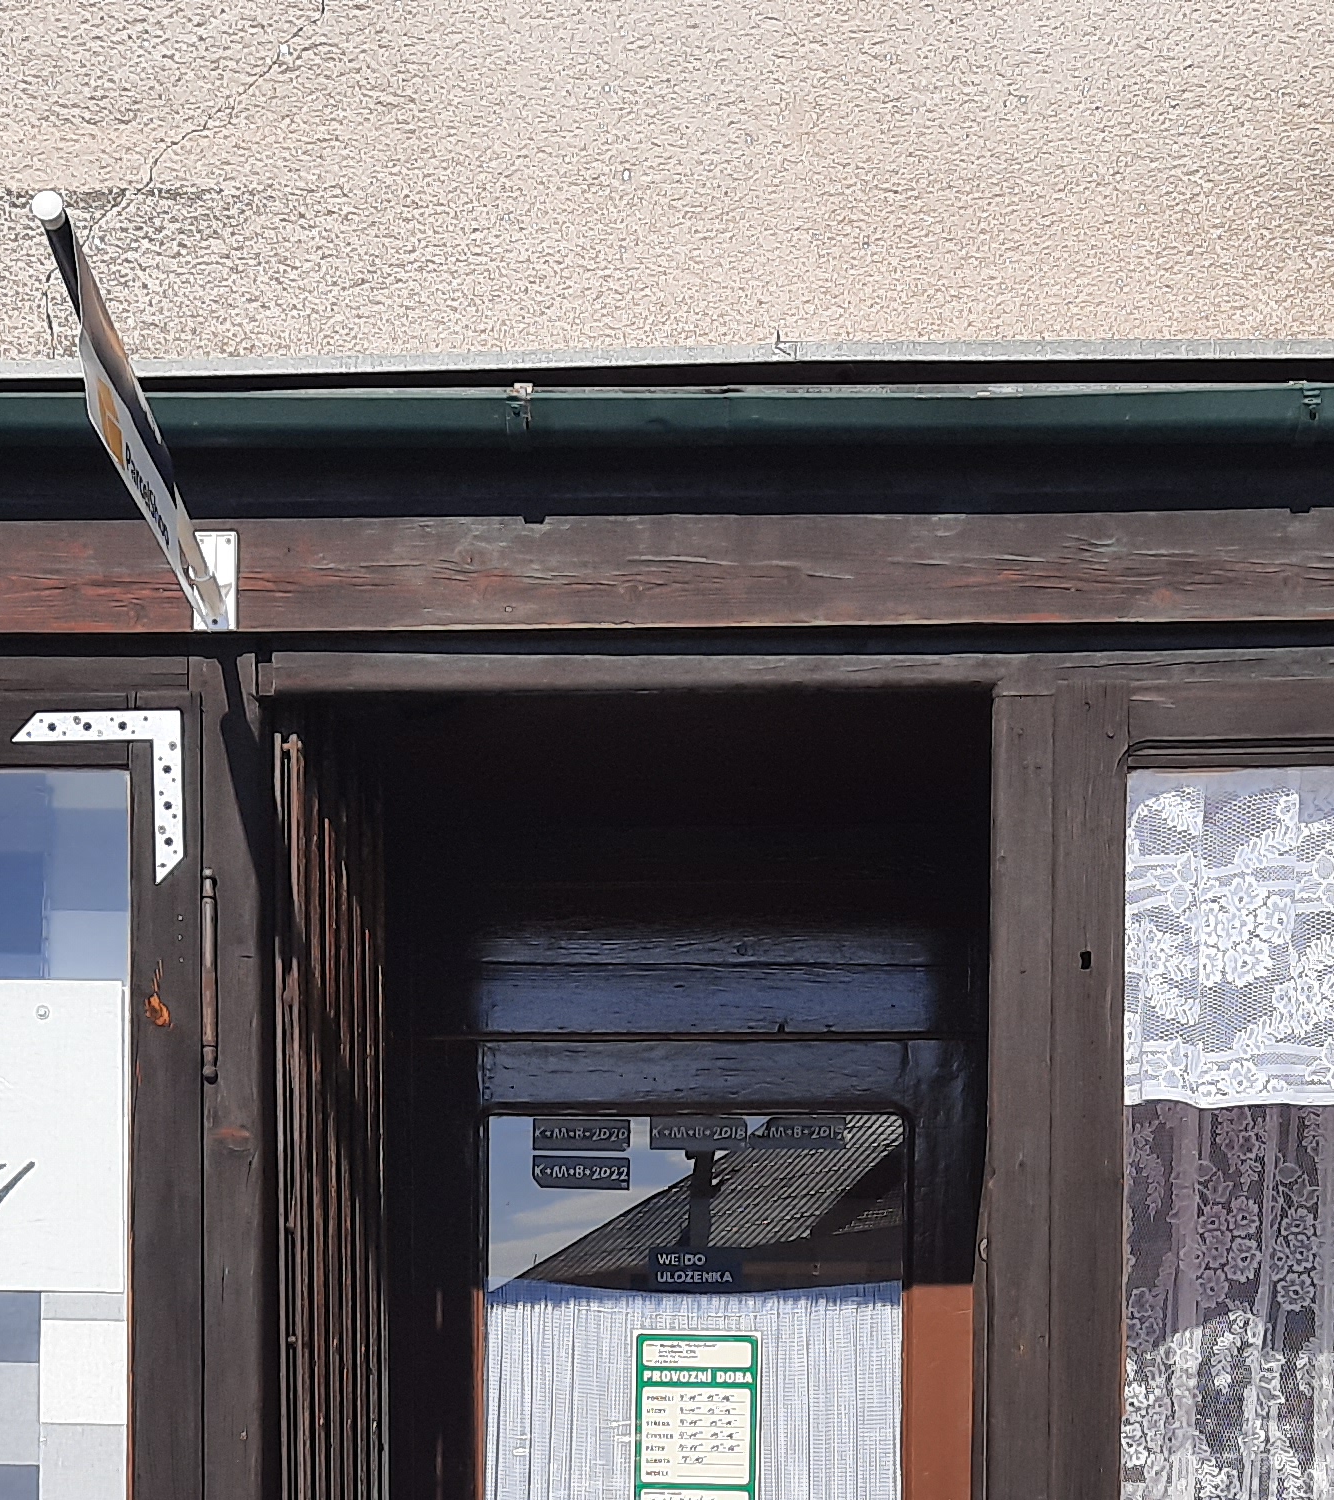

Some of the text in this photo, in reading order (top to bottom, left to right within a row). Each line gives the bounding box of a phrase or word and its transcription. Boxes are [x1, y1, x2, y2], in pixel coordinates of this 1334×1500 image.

[657, 1268, 733, 1283] ULOŽENKA
[643, 1368, 753, 1384] PROVOZNÍ DOBA
